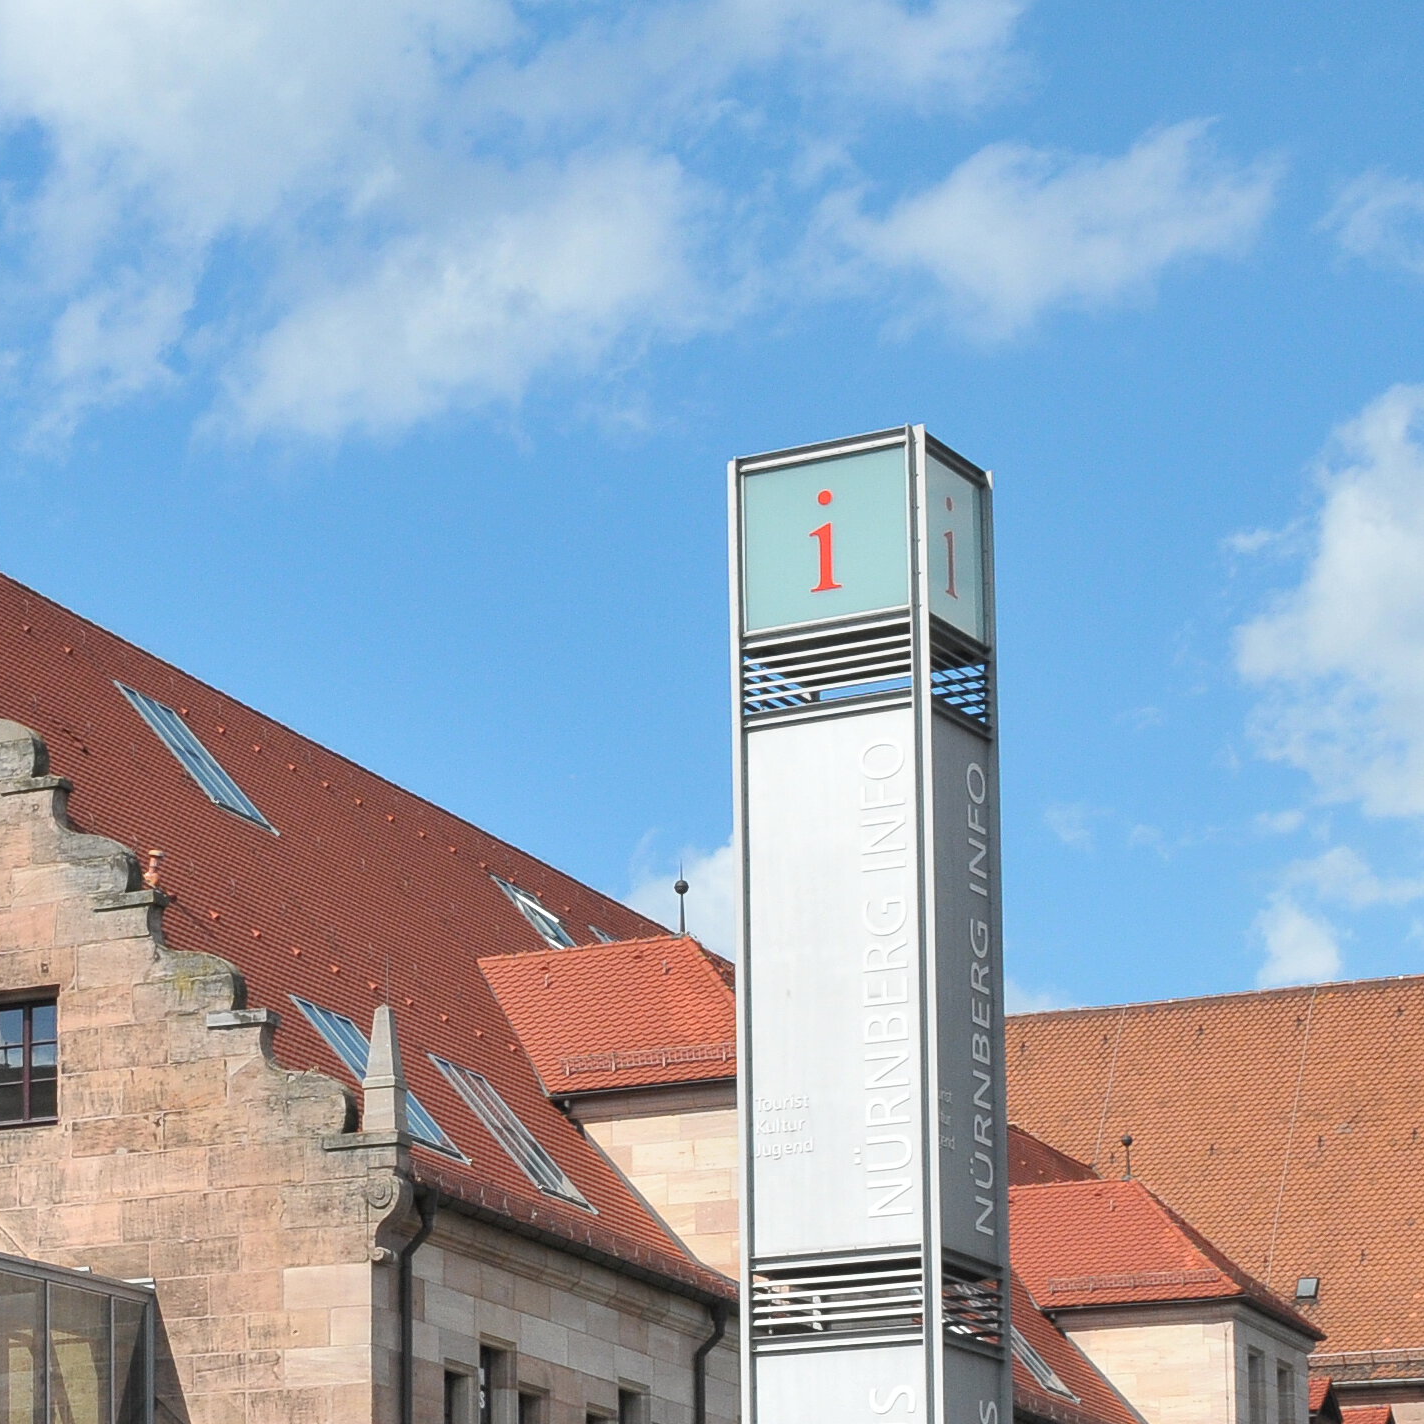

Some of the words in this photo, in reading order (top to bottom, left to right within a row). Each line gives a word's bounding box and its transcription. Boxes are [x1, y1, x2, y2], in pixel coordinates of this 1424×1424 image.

[858, 742, 908, 873] INFO
[965, 762, 989, 897] INFO
[755, 1095, 809, 1112] Tourist
[854, 896, 914, 1220] NÜRNBERG
[969, 920, 996, 1237] NÜRNBERG
[755, 1137, 814, 1160] Jugend
[757, 1118, 806, 1135] Kultur
